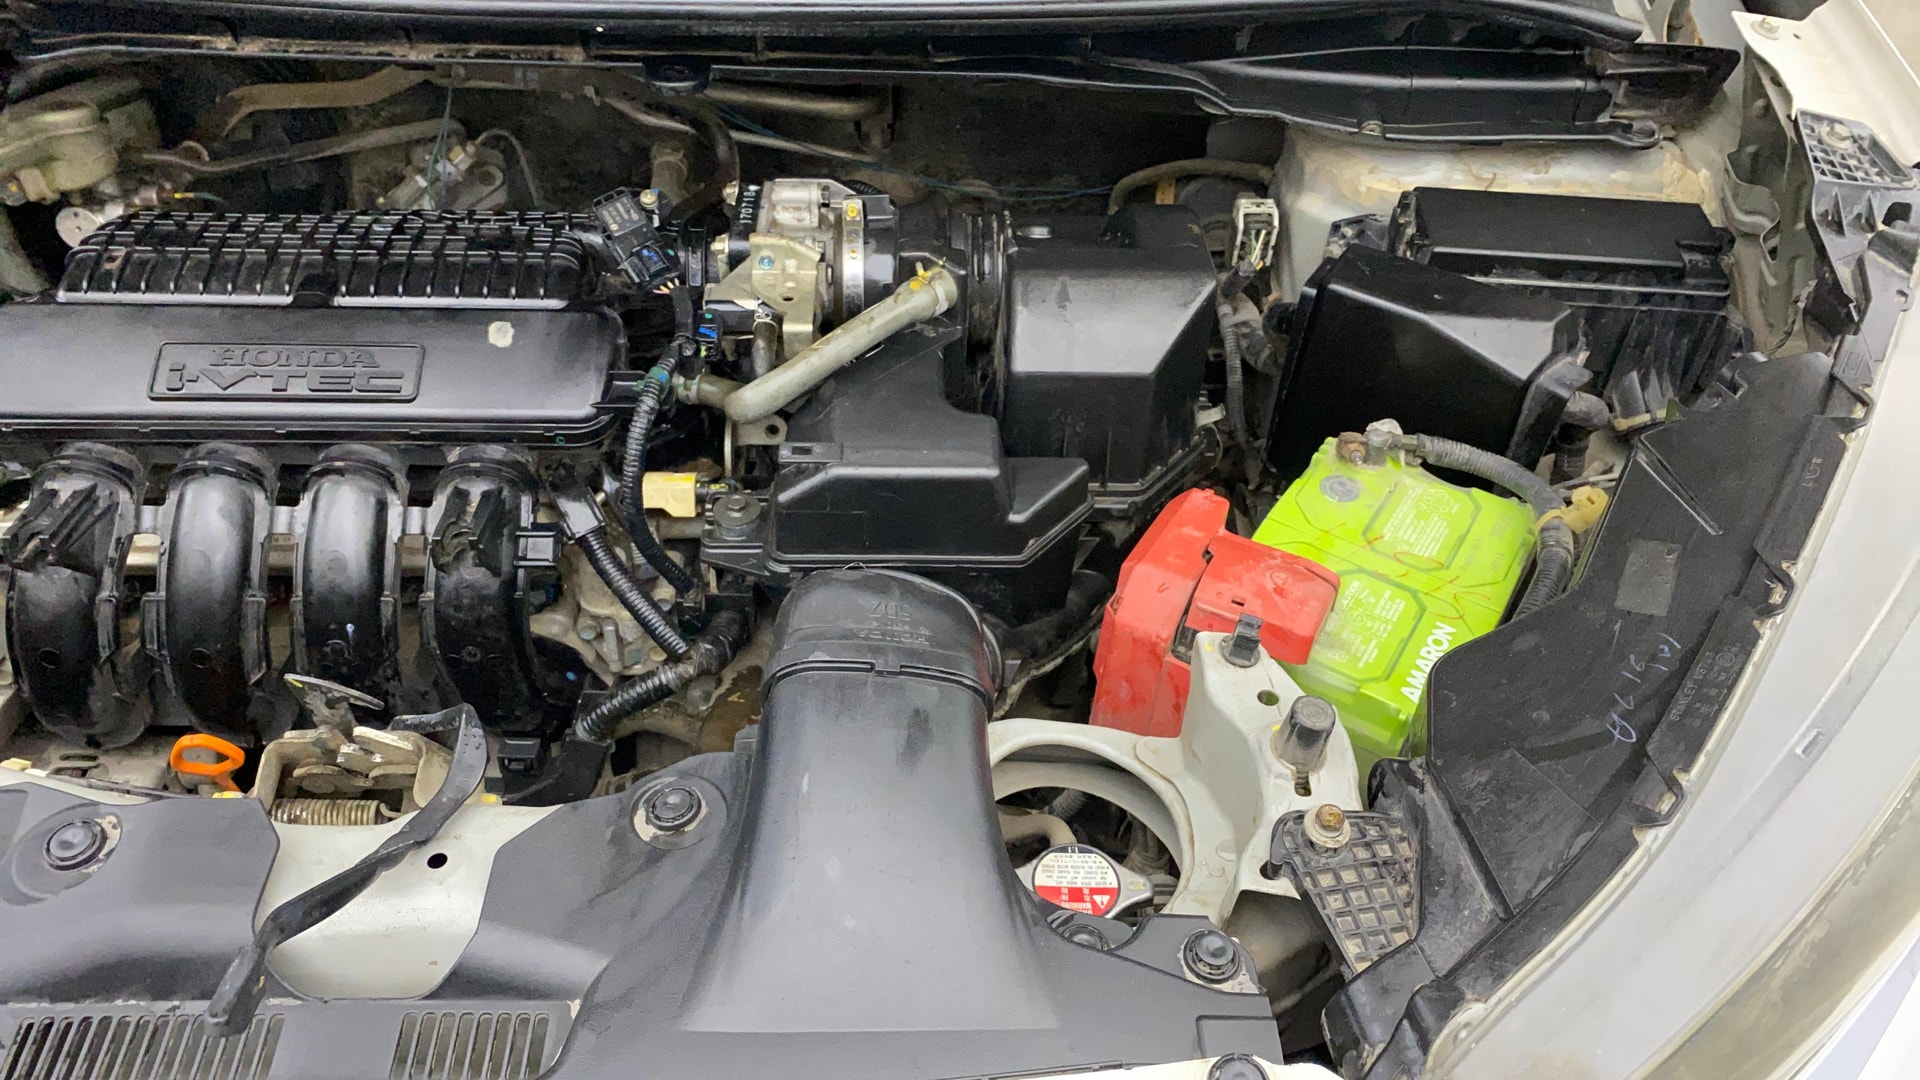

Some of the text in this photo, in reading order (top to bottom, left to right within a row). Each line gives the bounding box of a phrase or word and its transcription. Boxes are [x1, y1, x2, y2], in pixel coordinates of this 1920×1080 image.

[739, 191, 756, 224] 170718
[208, 349, 380, 368] HONDA
[1400, 621, 1457, 704] AMARON
